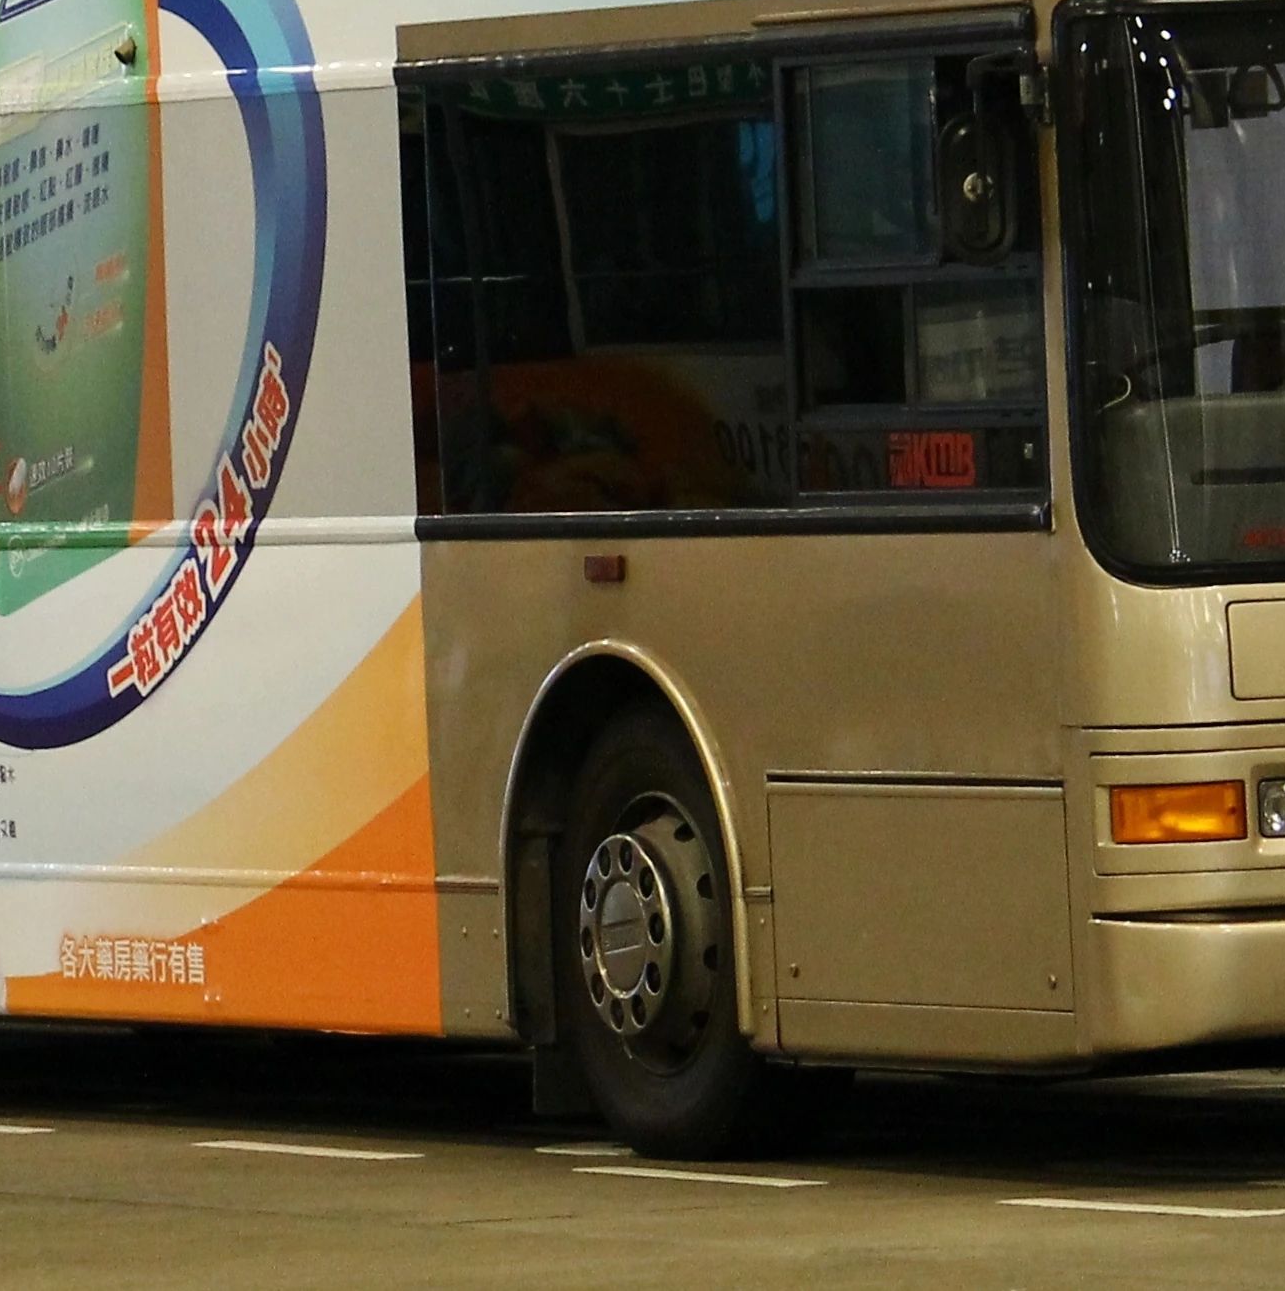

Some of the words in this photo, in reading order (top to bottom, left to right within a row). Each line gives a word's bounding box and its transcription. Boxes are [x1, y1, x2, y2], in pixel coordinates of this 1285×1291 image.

[60, 937, 205, 985] 各大藥房藥行有售
